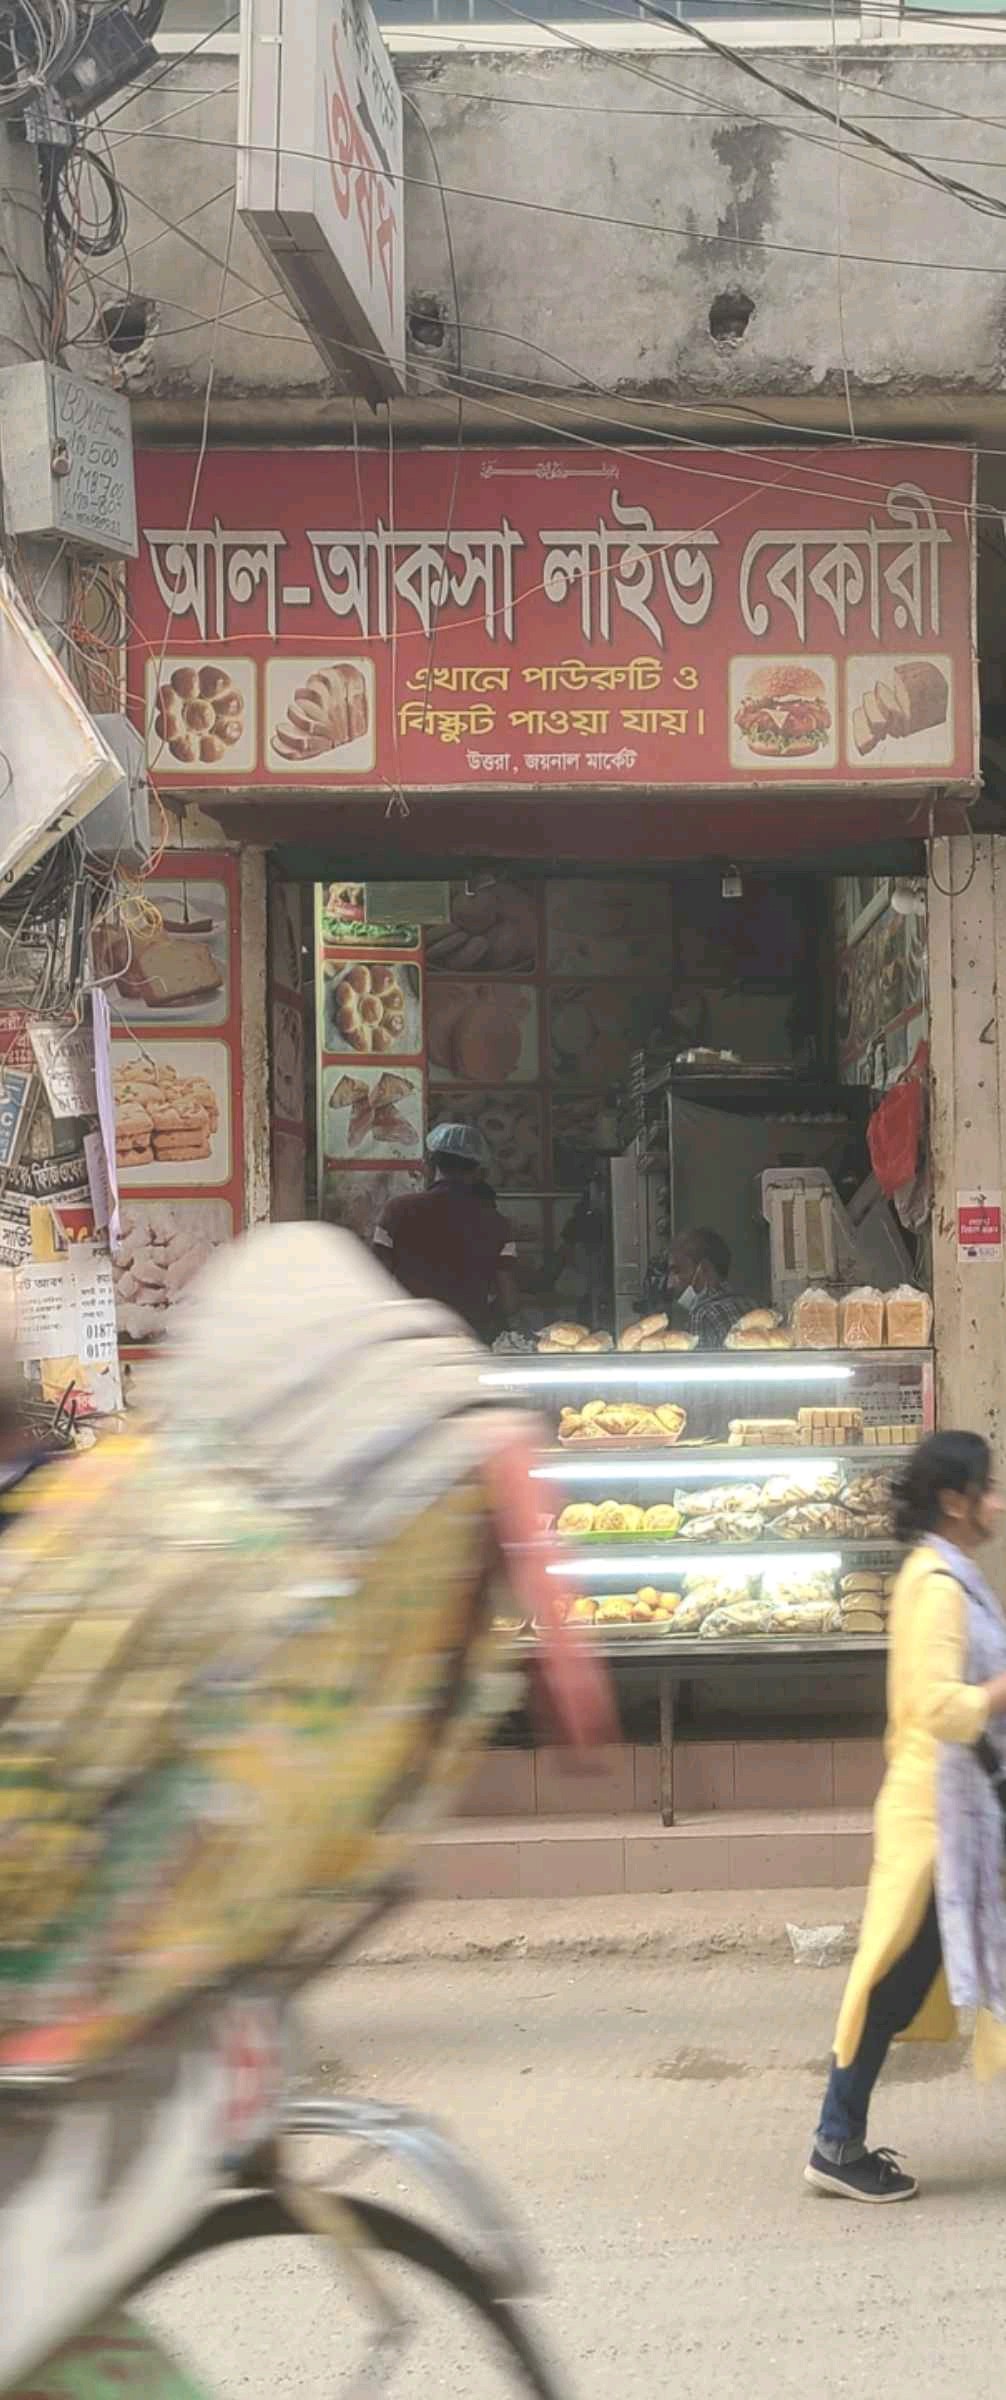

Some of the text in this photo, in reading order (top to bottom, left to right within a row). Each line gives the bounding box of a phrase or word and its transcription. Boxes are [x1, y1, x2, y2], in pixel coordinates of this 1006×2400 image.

[142, 482, 953, 648] আল-আকসা লাইভ বেকারী
[406, 656, 699, 693] এখানে পাউরুটি ও
[508, 709, 610, 736] পাওয়া
[524, 752, 581, 771] জয়নাল
[586, 746, 638, 770] মার্কেট
